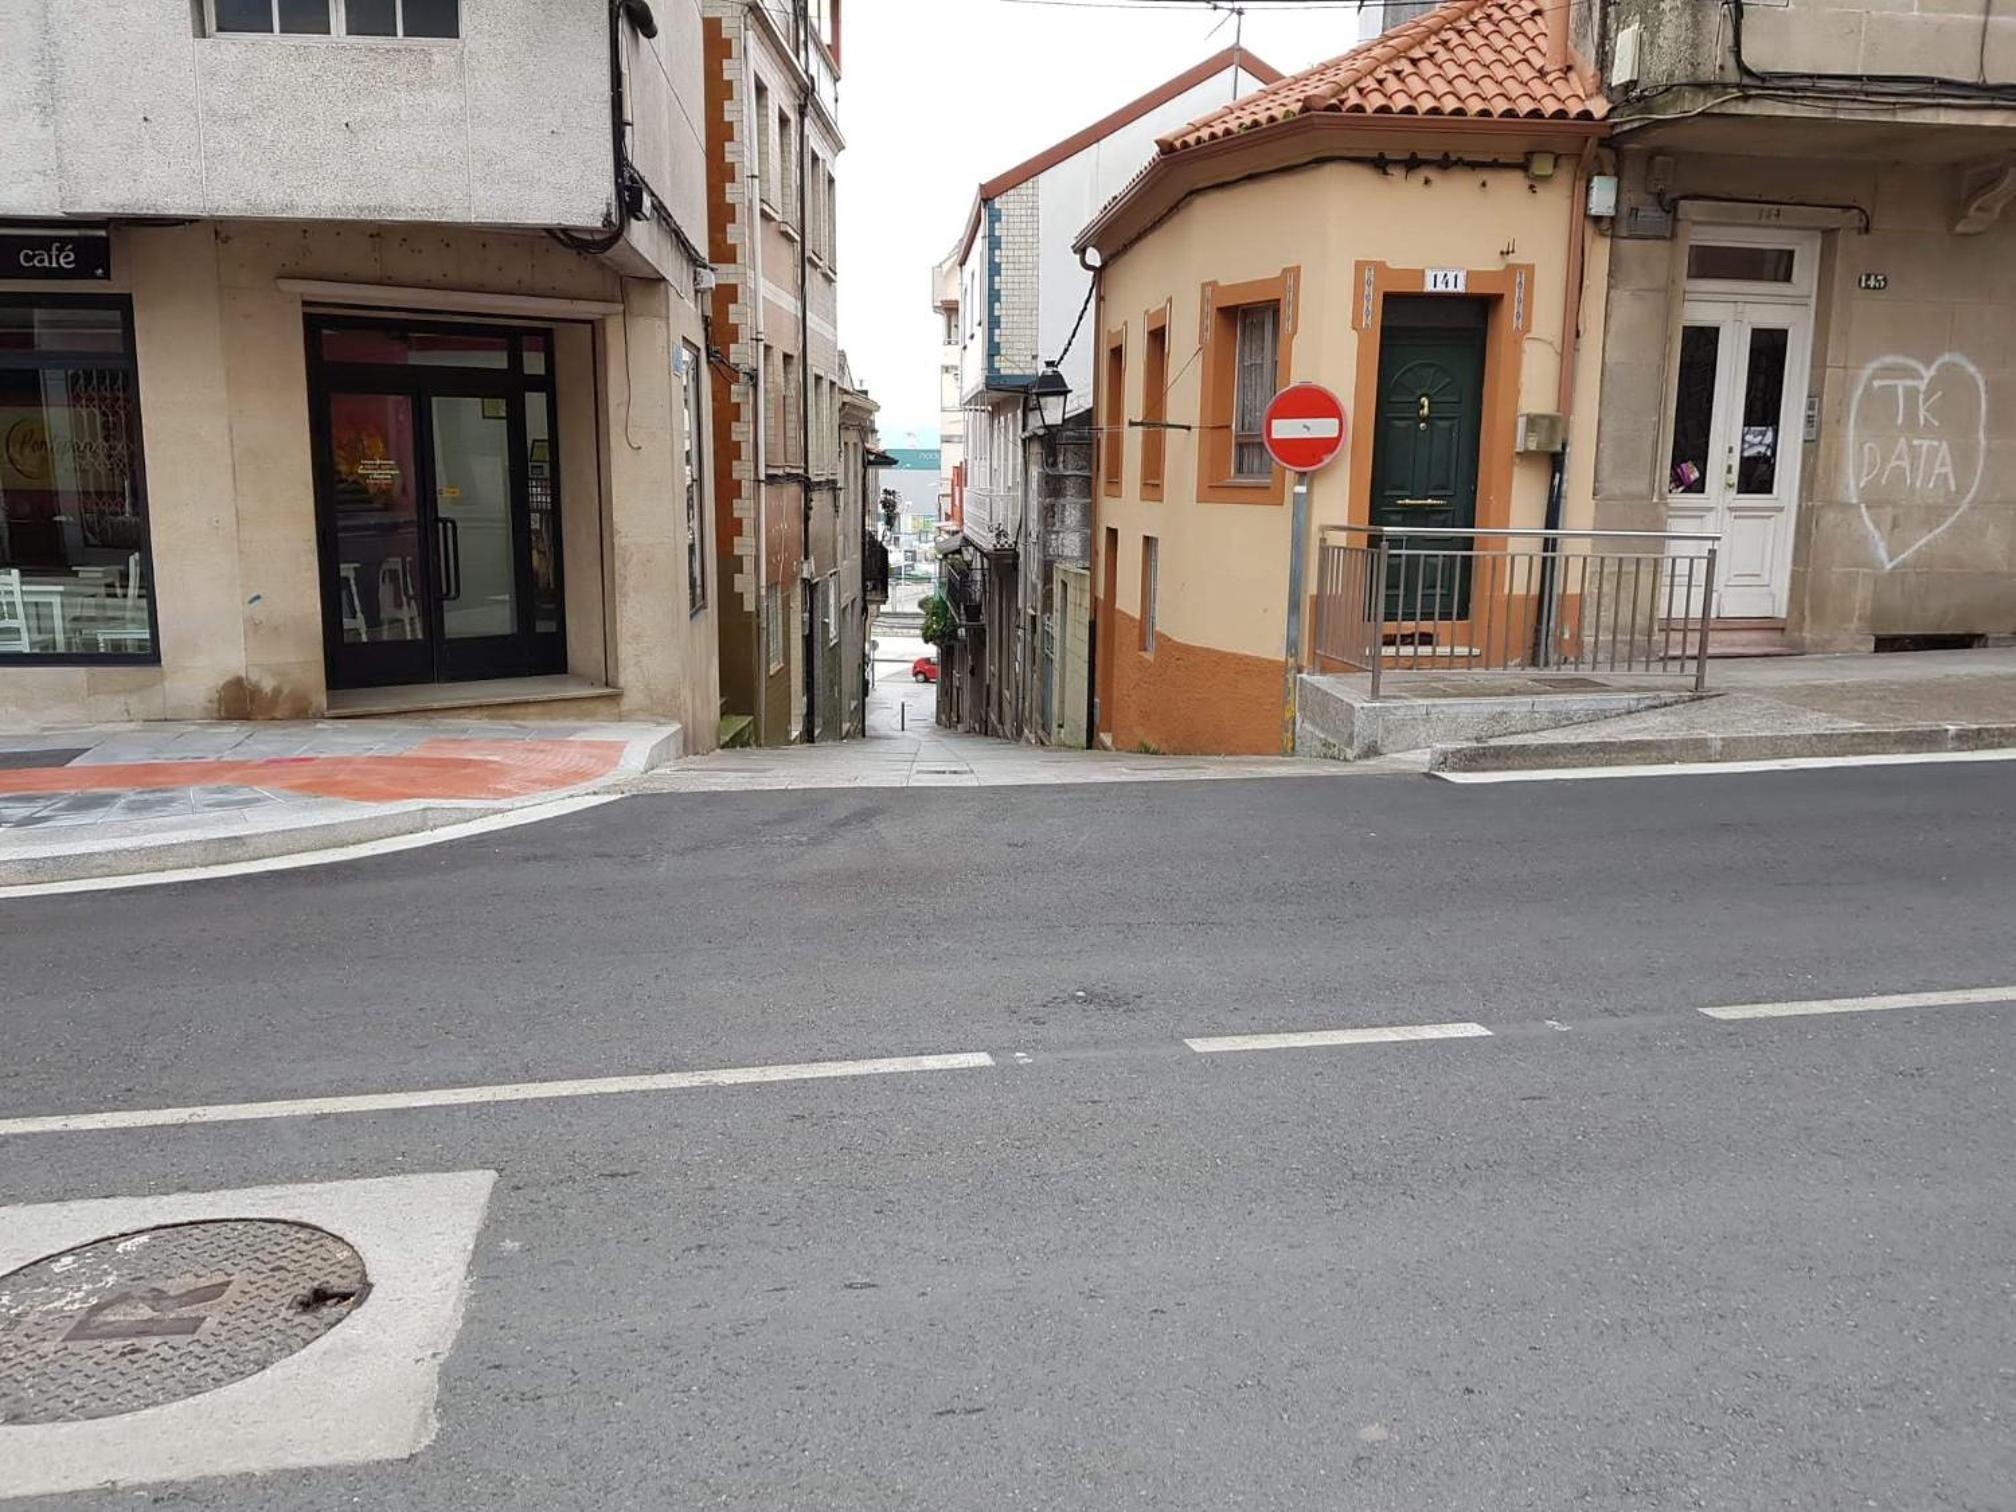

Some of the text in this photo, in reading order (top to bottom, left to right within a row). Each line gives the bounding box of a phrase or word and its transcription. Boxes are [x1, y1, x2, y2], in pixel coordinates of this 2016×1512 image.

[19, 243, 76, 268] café
[1432, 272, 1458, 289] 141
[1872, 378, 1943, 428] TK
[1858, 437, 1957, 491] DATA
